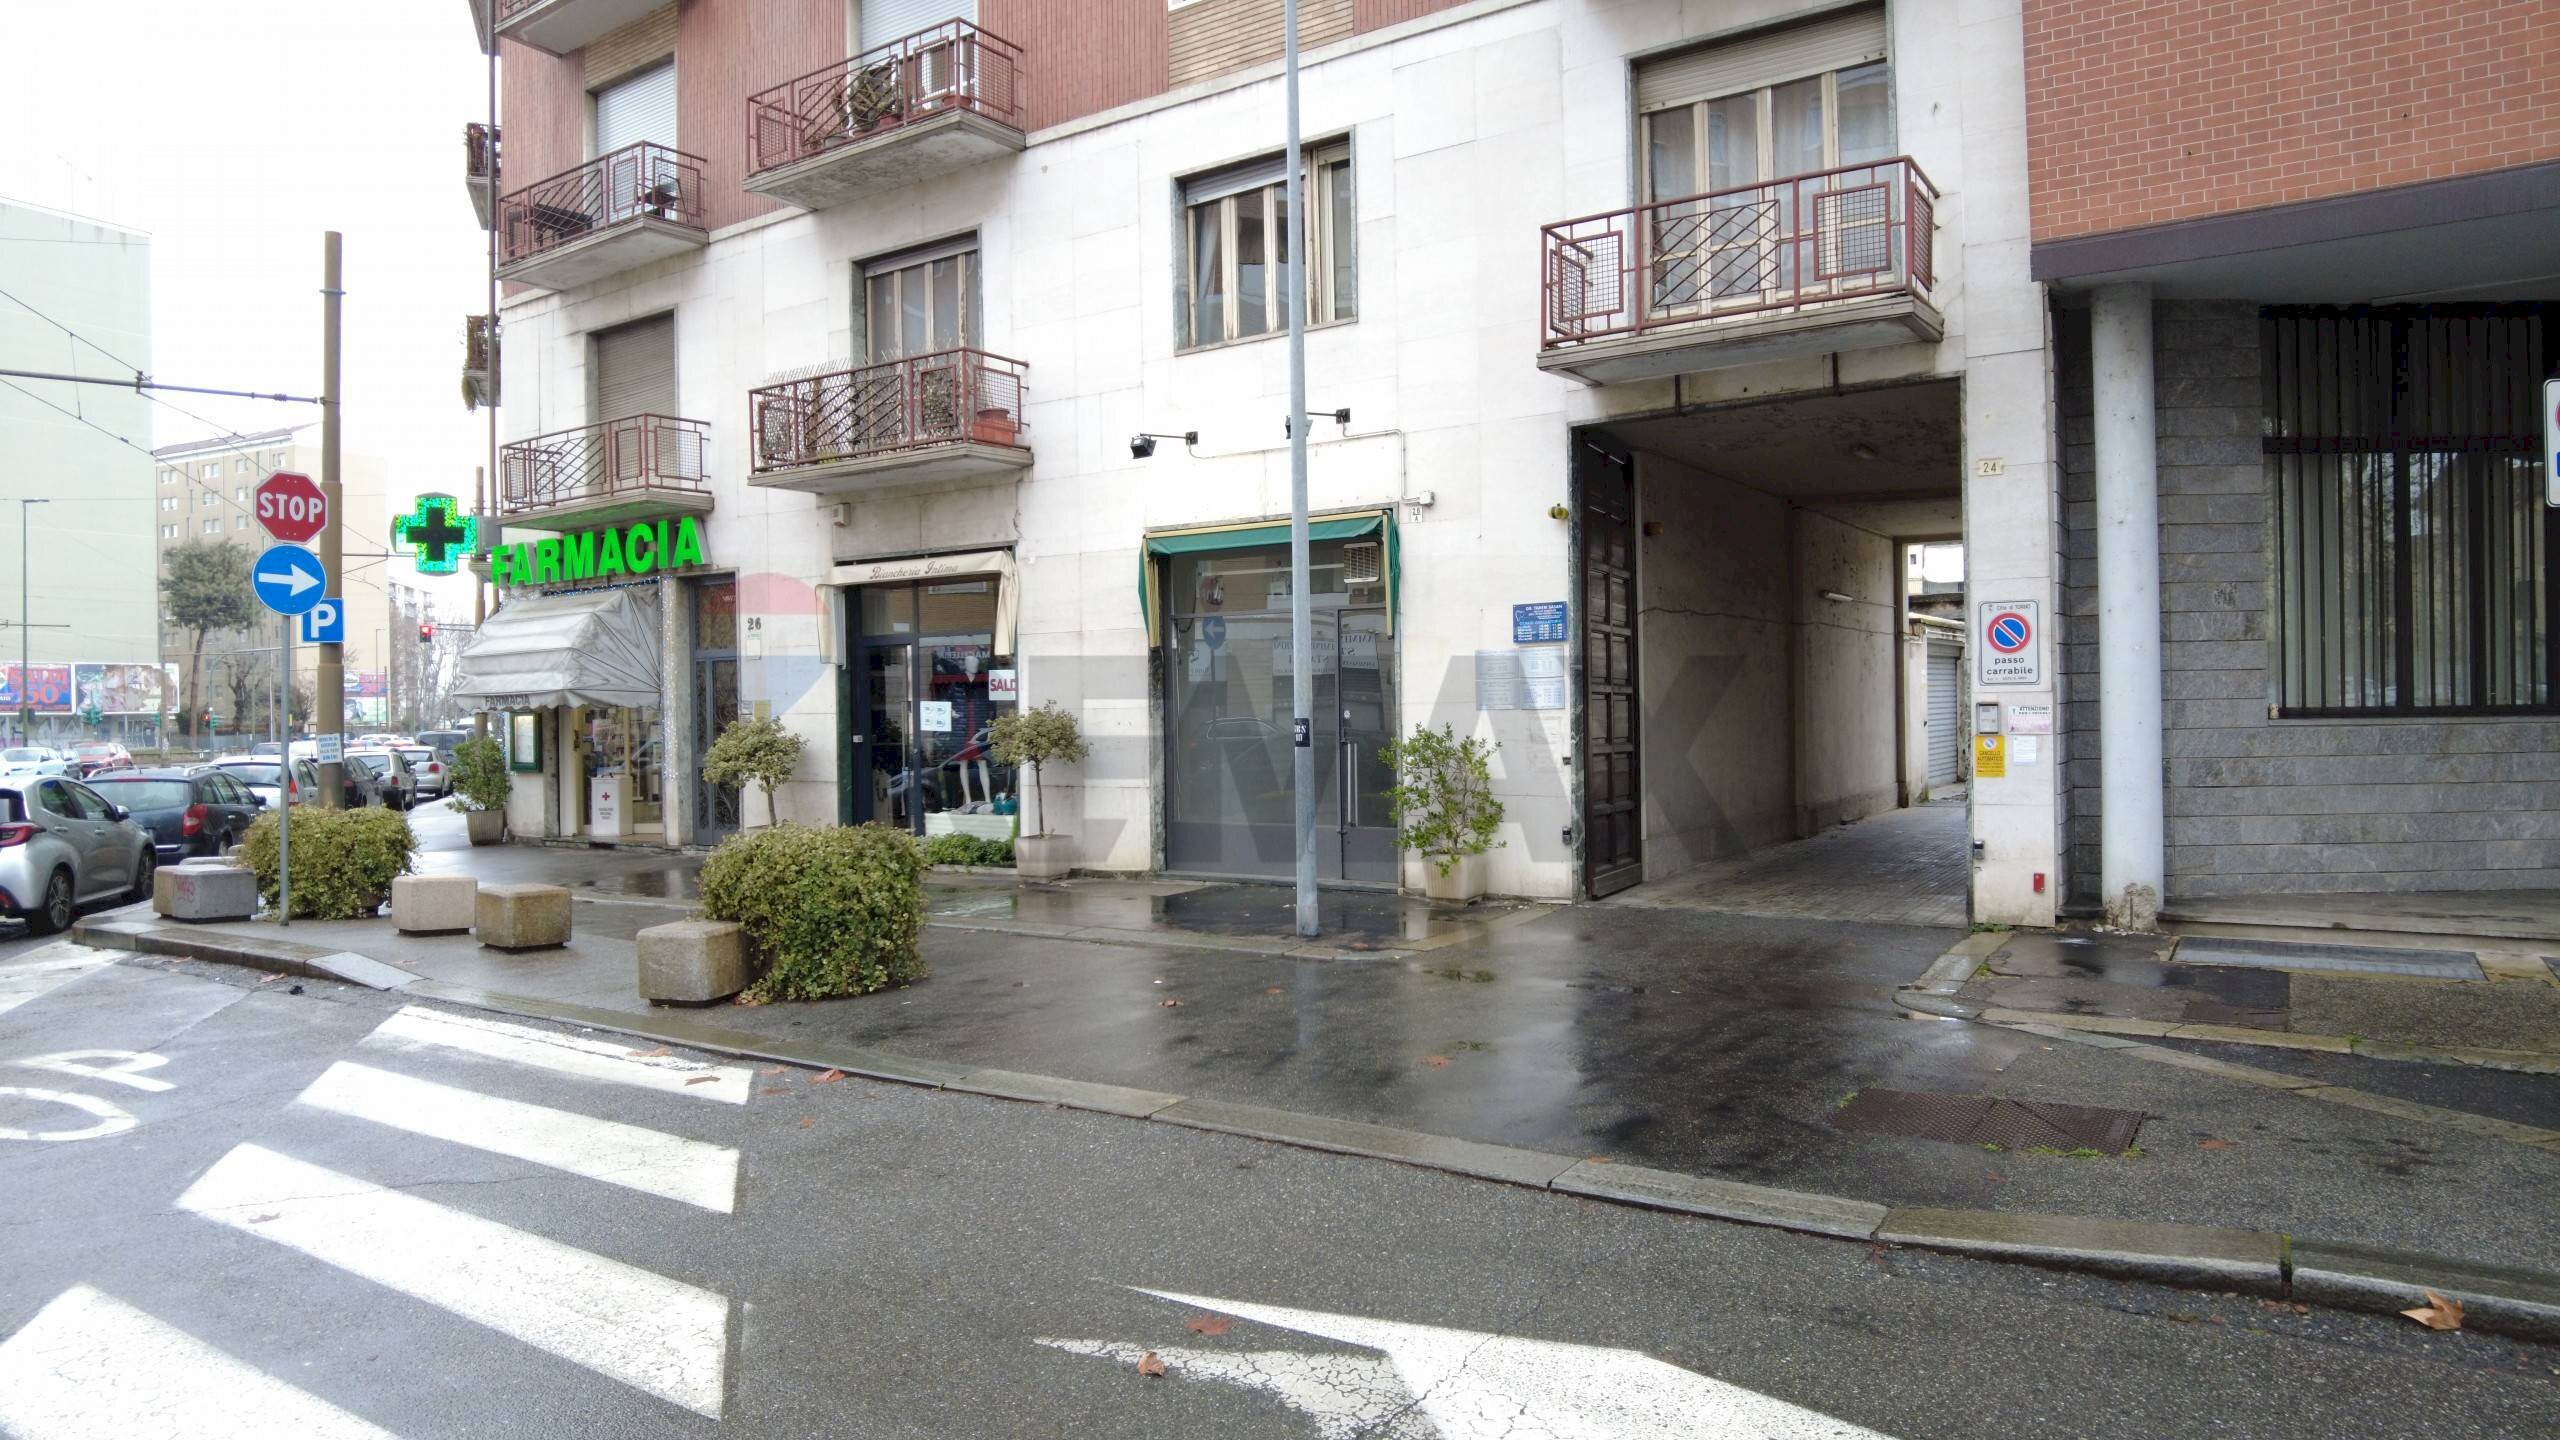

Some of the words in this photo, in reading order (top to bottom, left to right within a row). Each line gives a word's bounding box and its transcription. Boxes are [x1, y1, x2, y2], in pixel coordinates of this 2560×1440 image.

[1983, 462, 1997, 473] 24
[260, 492, 322, 523] STOP
[490, 516, 704, 588] FARMACIA
[924, 560, 959, 575] Intima
[310, 603, 337, 639] P
[747, 617, 762, 630] 26
[1994, 657, 2025, 665] passo
[1986, 667, 2033, 675] carrabile
[485, 695, 531, 706] FARMACIA
